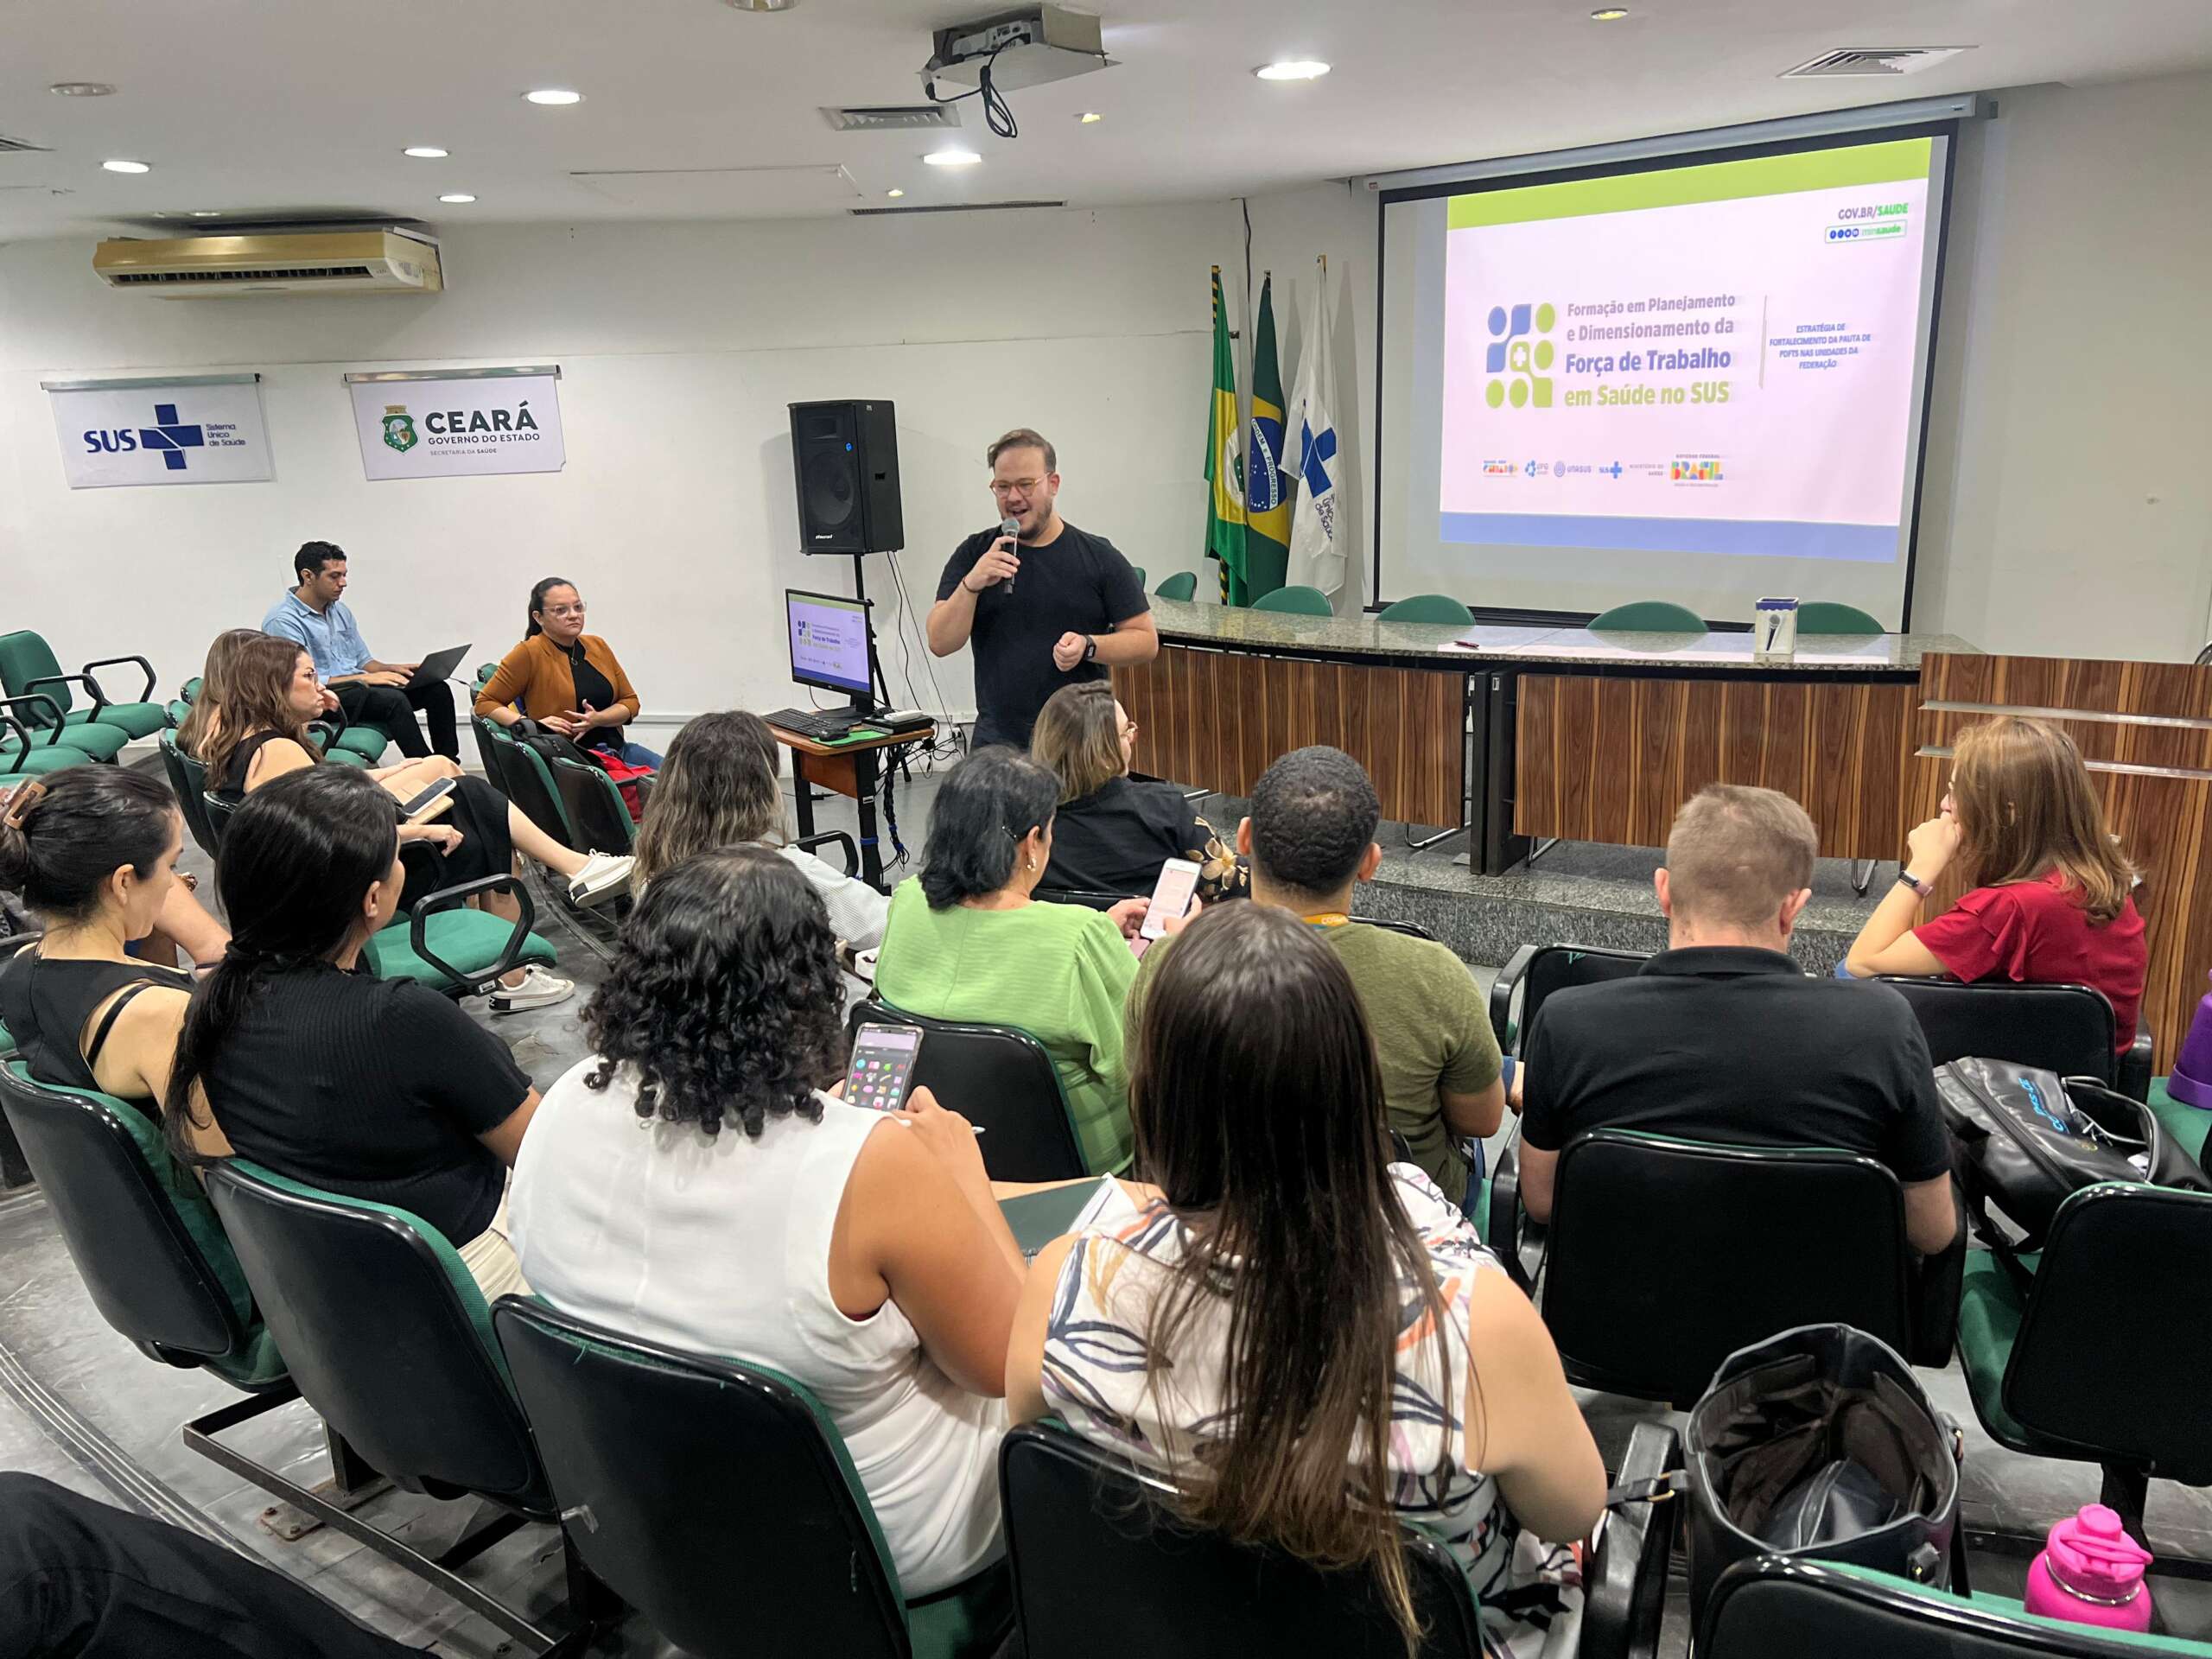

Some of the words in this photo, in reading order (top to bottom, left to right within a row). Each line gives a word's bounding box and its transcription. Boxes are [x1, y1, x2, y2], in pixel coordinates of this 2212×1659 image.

[1567, 301, 1624, 318] Formação
[1627, 302, 1645, 314] em
[1649, 294, 1735, 312] Planejamento
[1567, 329, 1575, 341] e
[1579, 319, 1710, 341] Dimensionamento
[1714, 317, 1734, 334] da
[1770, 336, 1827, 346] FORTALECIMENTO
[1828, 335, 1838, 344] DA
[1839, 334, 1860, 343] PAUTA
[1796, 323, 1836, 333] ESTRATÉGIA
[1566, 353, 1613, 377] Força
[1619, 351, 1642, 371] de
[1647, 348, 1732, 370] Trabalho
[1800, 348, 1814, 357] NAS
[1815, 347, 1847, 356] UNIDADES
[1799, 359, 1837, 370] FEDERAÇÃO
[1564, 391, 1592, 406] em
[1597, 384, 1656, 405] Saúde
[1661, 388, 1685, 404] no
[1690, 381, 1729, 404] SUS
[425, 400, 539, 434] CEARÁ
[84, 429, 137, 453] SUS
[428, 435, 480, 445] GOVERNO
[482, 435, 497, 443] DO
[500, 433, 540, 442] ESTADO
[1266, 455, 1278, 505] PROGRESSO
[1315, 503, 1324, 516] de
